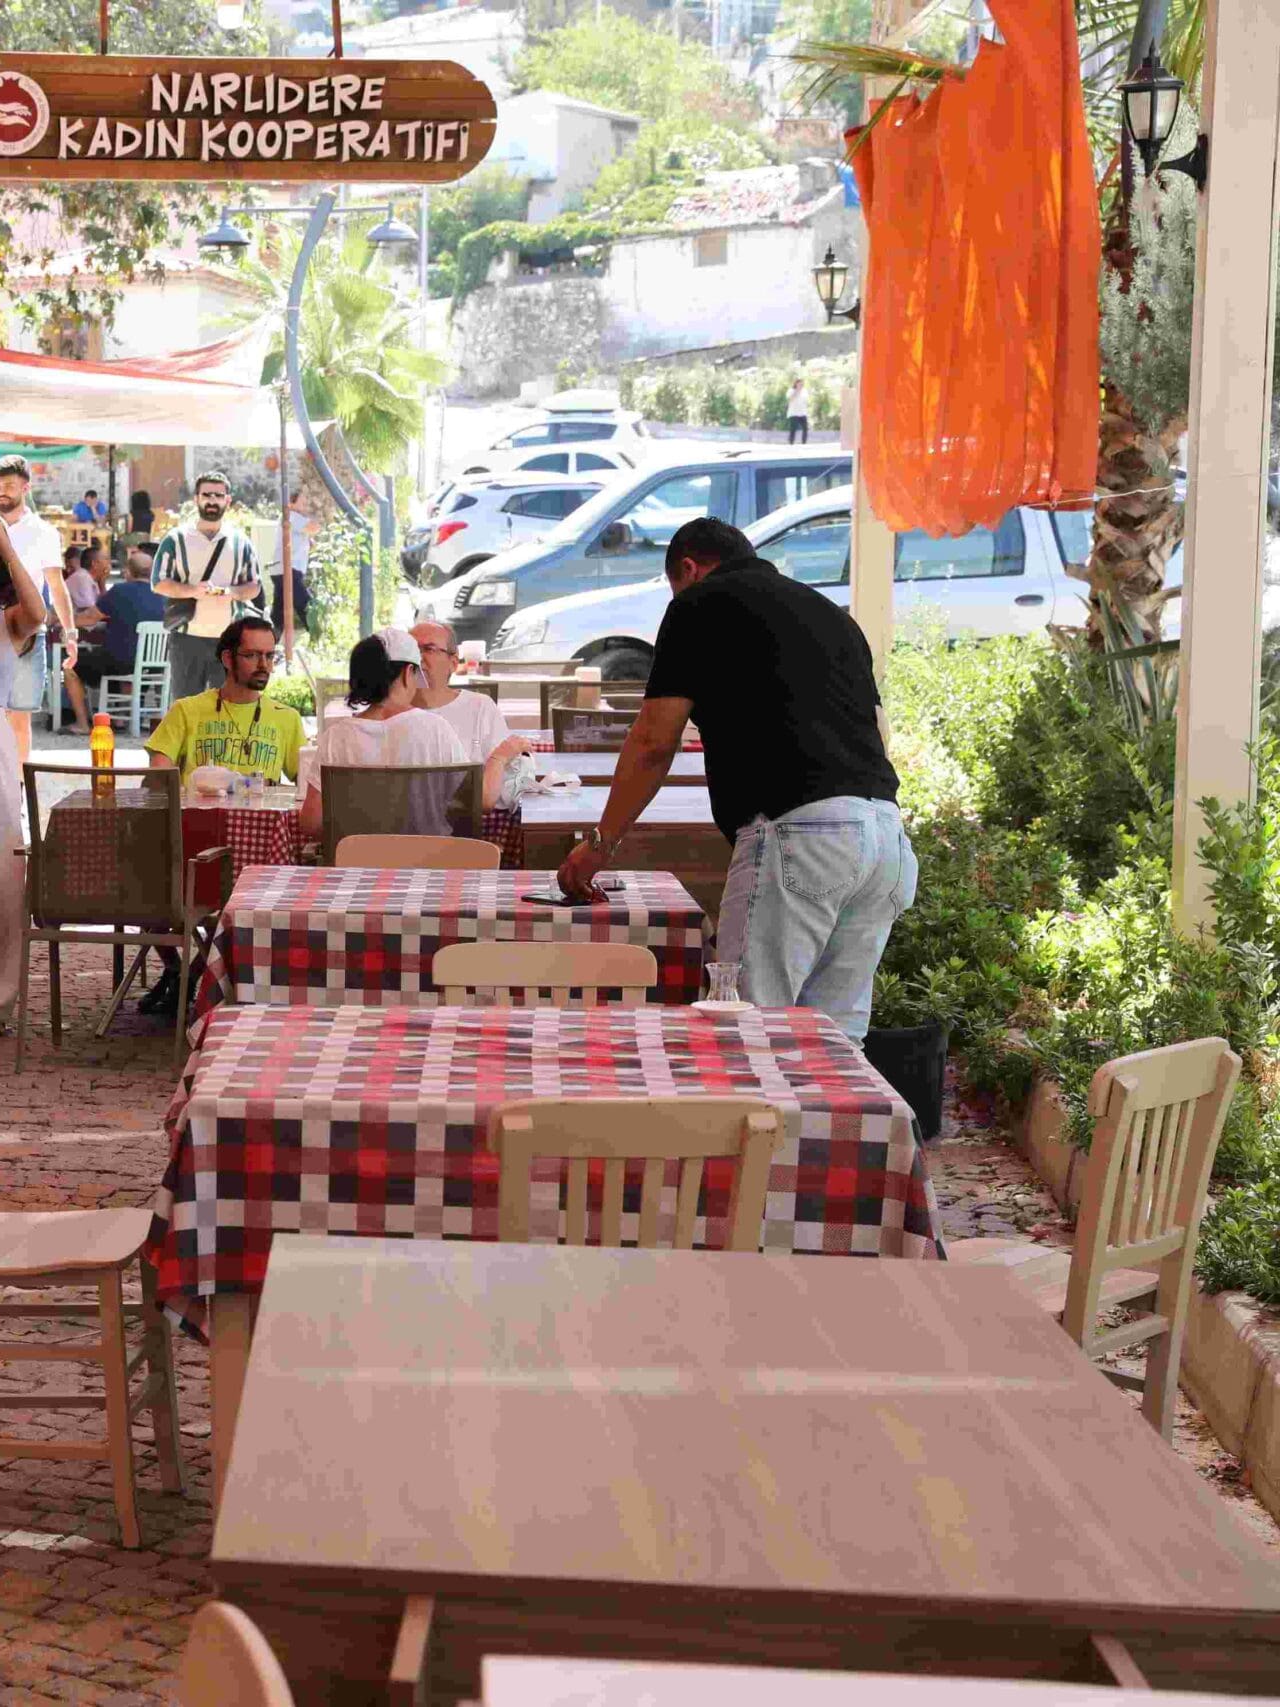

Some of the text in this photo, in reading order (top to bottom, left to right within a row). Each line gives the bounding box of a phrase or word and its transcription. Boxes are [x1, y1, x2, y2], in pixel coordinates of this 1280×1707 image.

[152, 72, 386, 116] NARLIDERE
[58, 116, 186, 160] KADIN
[195, 736, 279, 772] BARCELONA
